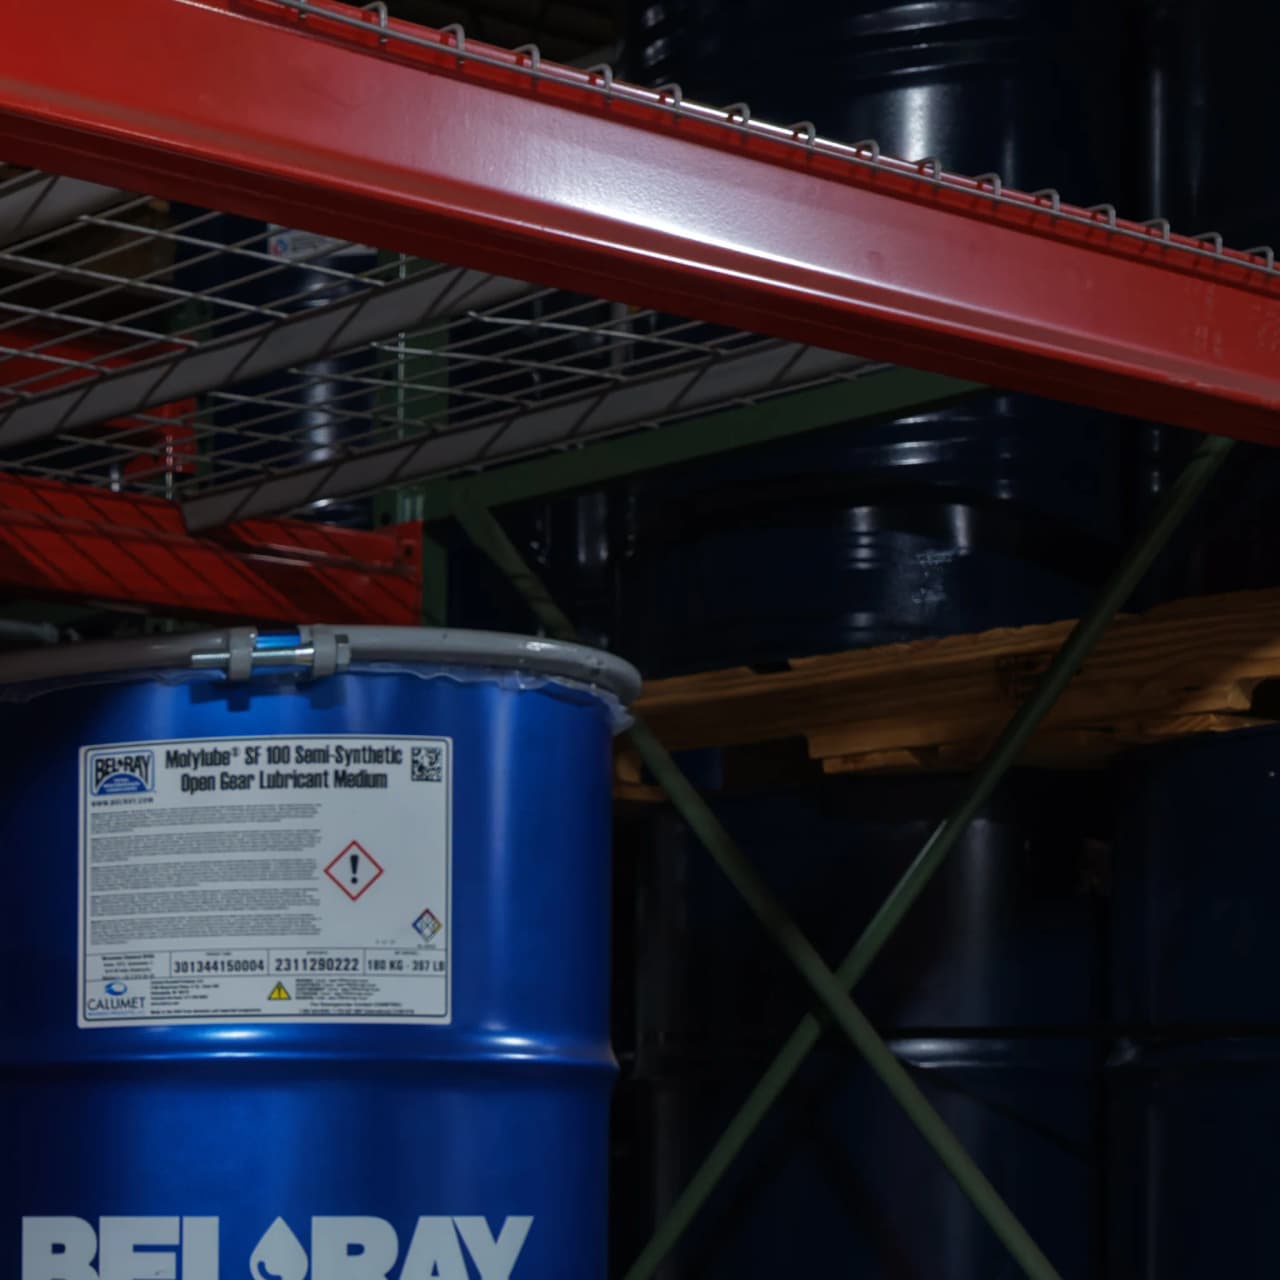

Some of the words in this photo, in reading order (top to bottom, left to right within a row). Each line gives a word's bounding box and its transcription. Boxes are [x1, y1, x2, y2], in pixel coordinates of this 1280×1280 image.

[245, 746, 262, 765] SF
[267, 745, 290, 764] 100
[295, 745, 403, 766] Semi-Synthetic
[181, 773, 216, 794] Open
[220, 771, 255, 791] Gear
[260, 770, 329, 789] Lubricant
[334, 770, 388, 788] Medium
[87, 997, 146, 1011] CALUMET
